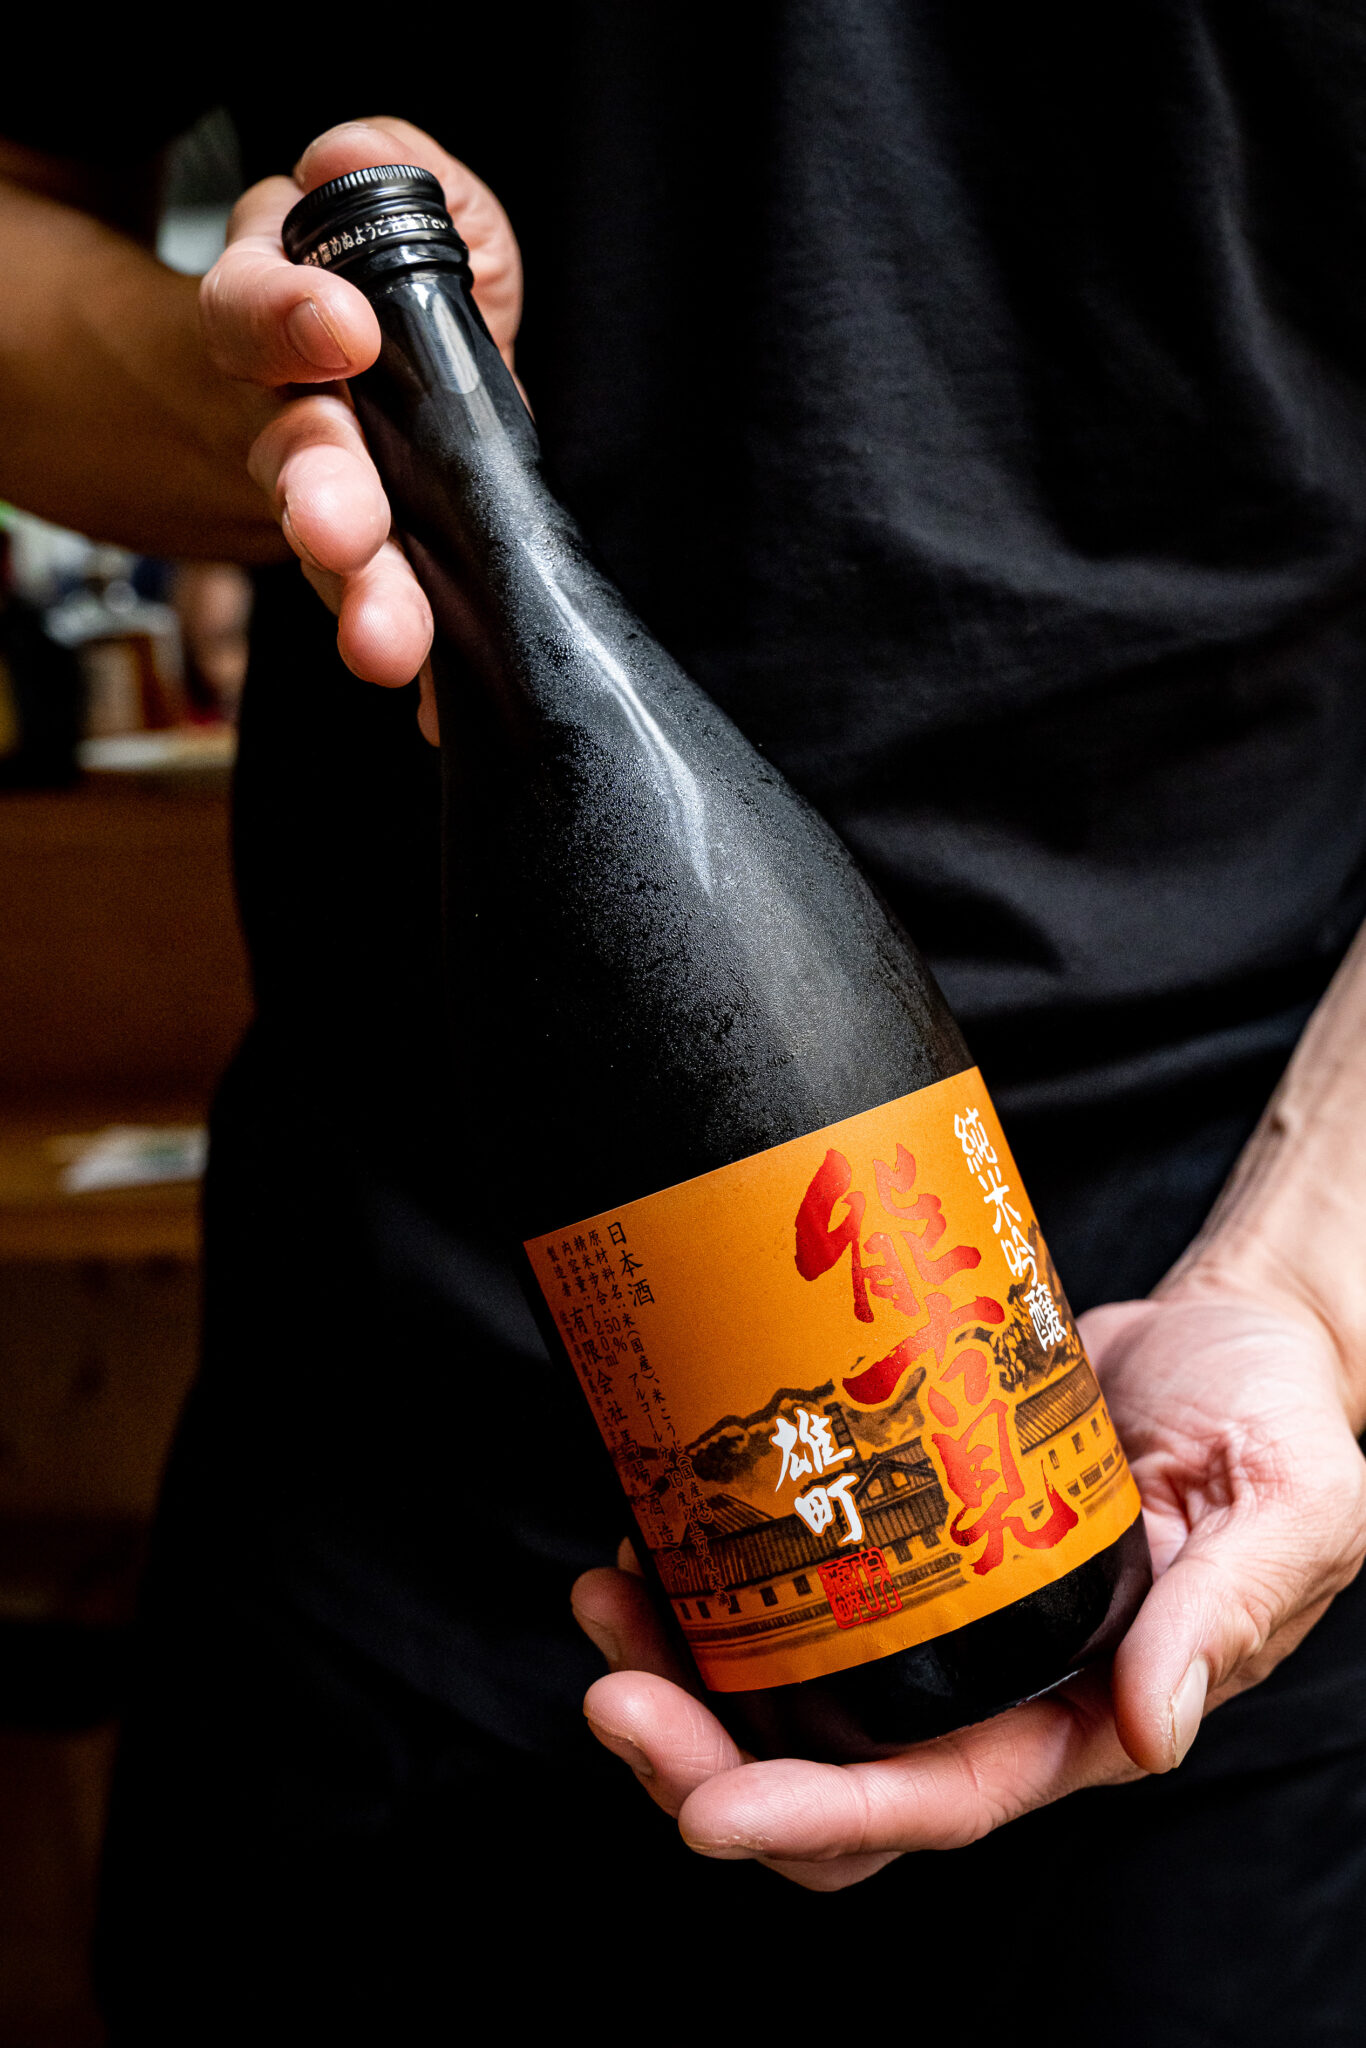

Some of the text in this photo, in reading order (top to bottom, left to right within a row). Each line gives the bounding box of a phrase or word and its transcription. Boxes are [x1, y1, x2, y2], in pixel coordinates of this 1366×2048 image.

[607, 1221, 655, 1307] 日本酒
[954, 1107, 1067, 1351] 純米吟醸
[795, 1143, 1079, 1576] 能古見
[770, 1409, 863, 1544] 雄町
